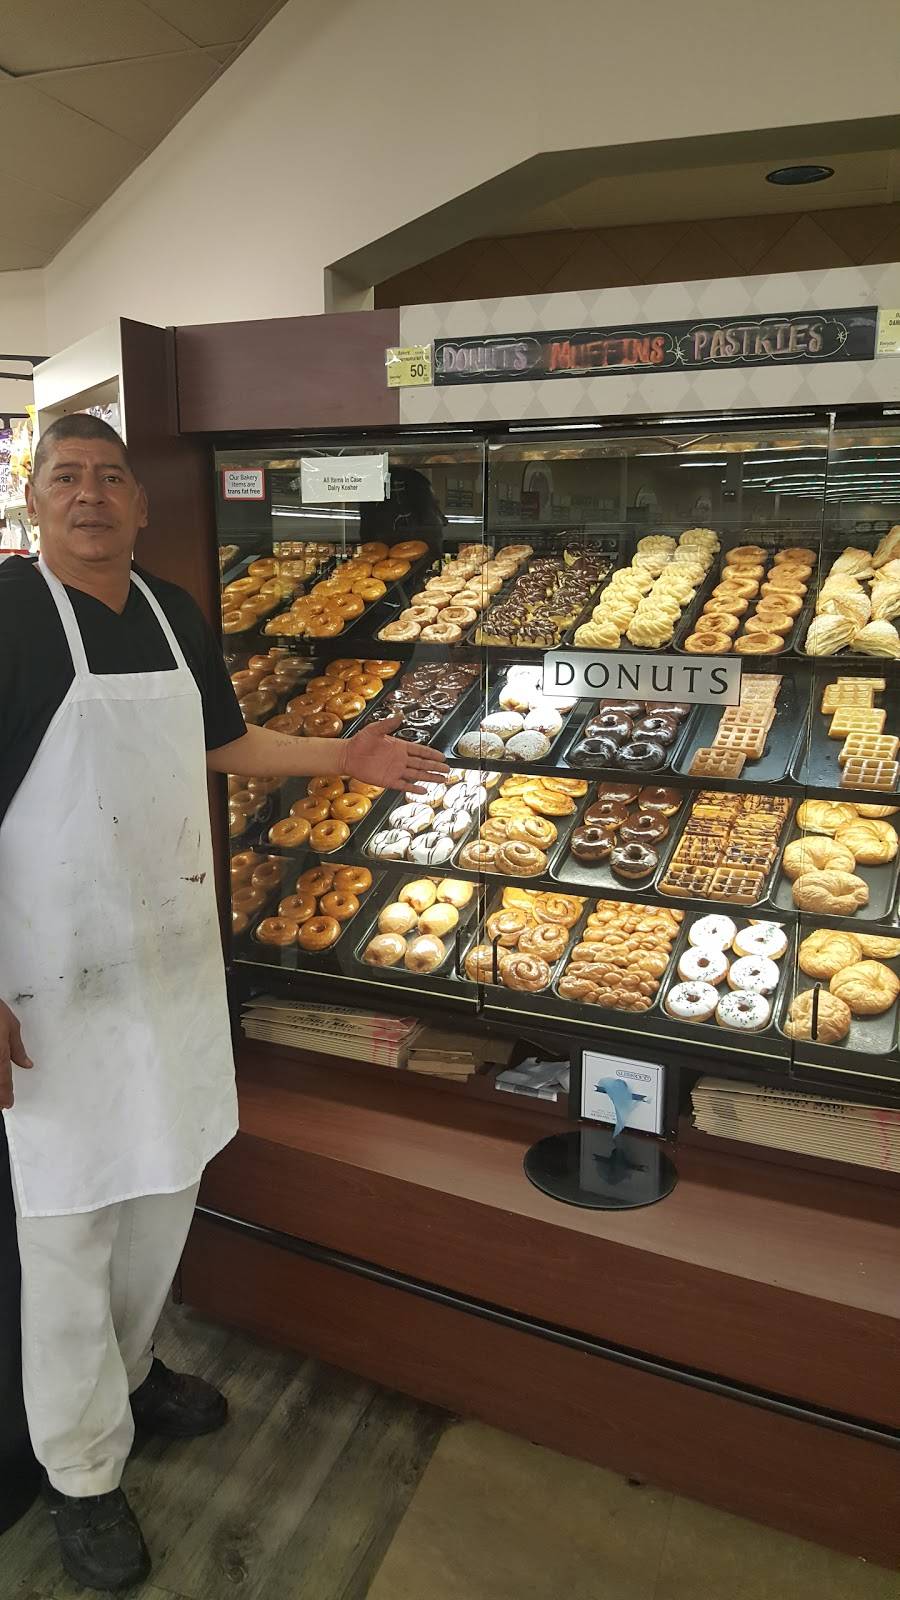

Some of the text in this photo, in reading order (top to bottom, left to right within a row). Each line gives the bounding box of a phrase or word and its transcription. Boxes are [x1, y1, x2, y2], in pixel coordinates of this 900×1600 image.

[443, 323, 823, 373] DONUTS MUFFINS PASTRIES
[241, 474, 258, 482] Bakery
[554, 661, 729, 695] DONUTS
